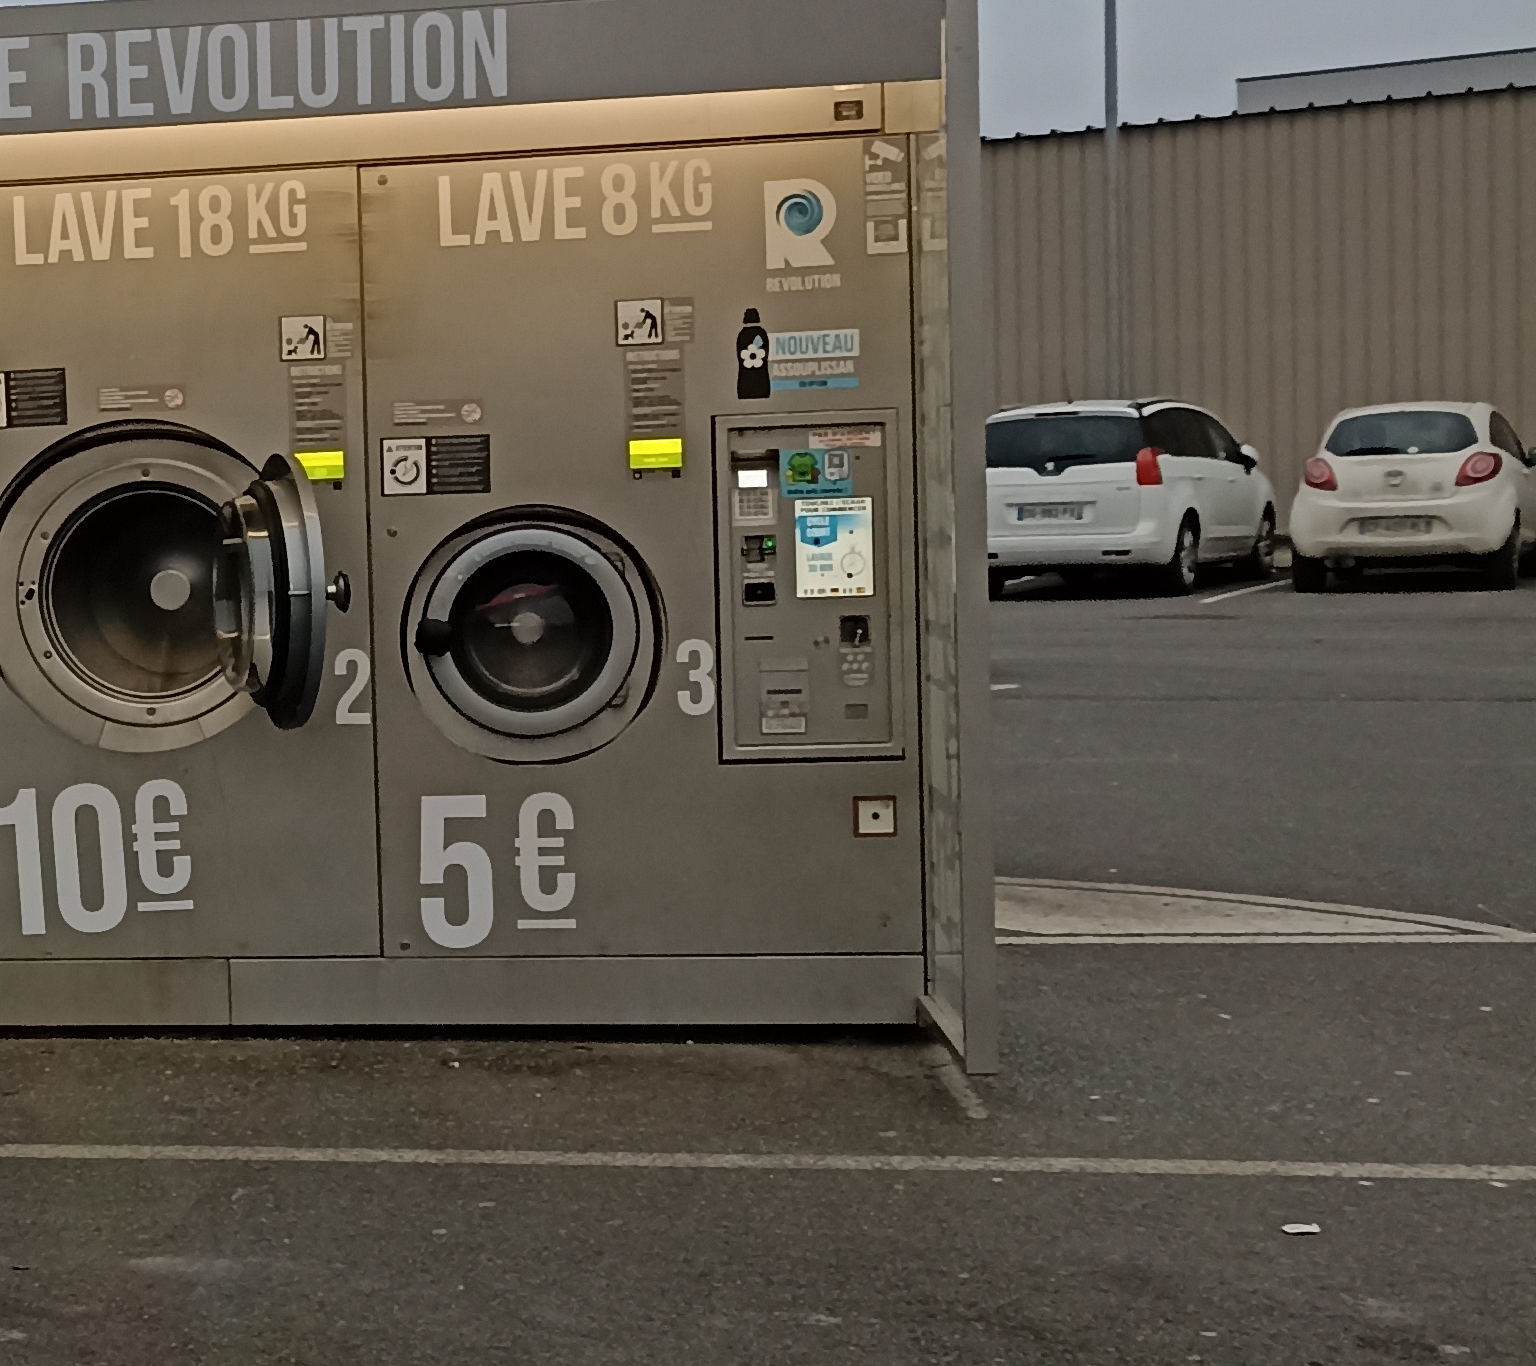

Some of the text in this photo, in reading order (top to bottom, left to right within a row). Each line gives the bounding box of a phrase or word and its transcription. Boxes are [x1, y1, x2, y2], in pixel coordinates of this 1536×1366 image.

[67, 8, 508, 120] REVOLUTION
[13, 180, 307, 266] LAVE 18 KG
[437, 158, 713, 247] LAVE 8 KG
[775, 333, 855, 356] NOUVEAU
[333, 648, 372, 725] 2
[676, 638, 715, 716] 3
